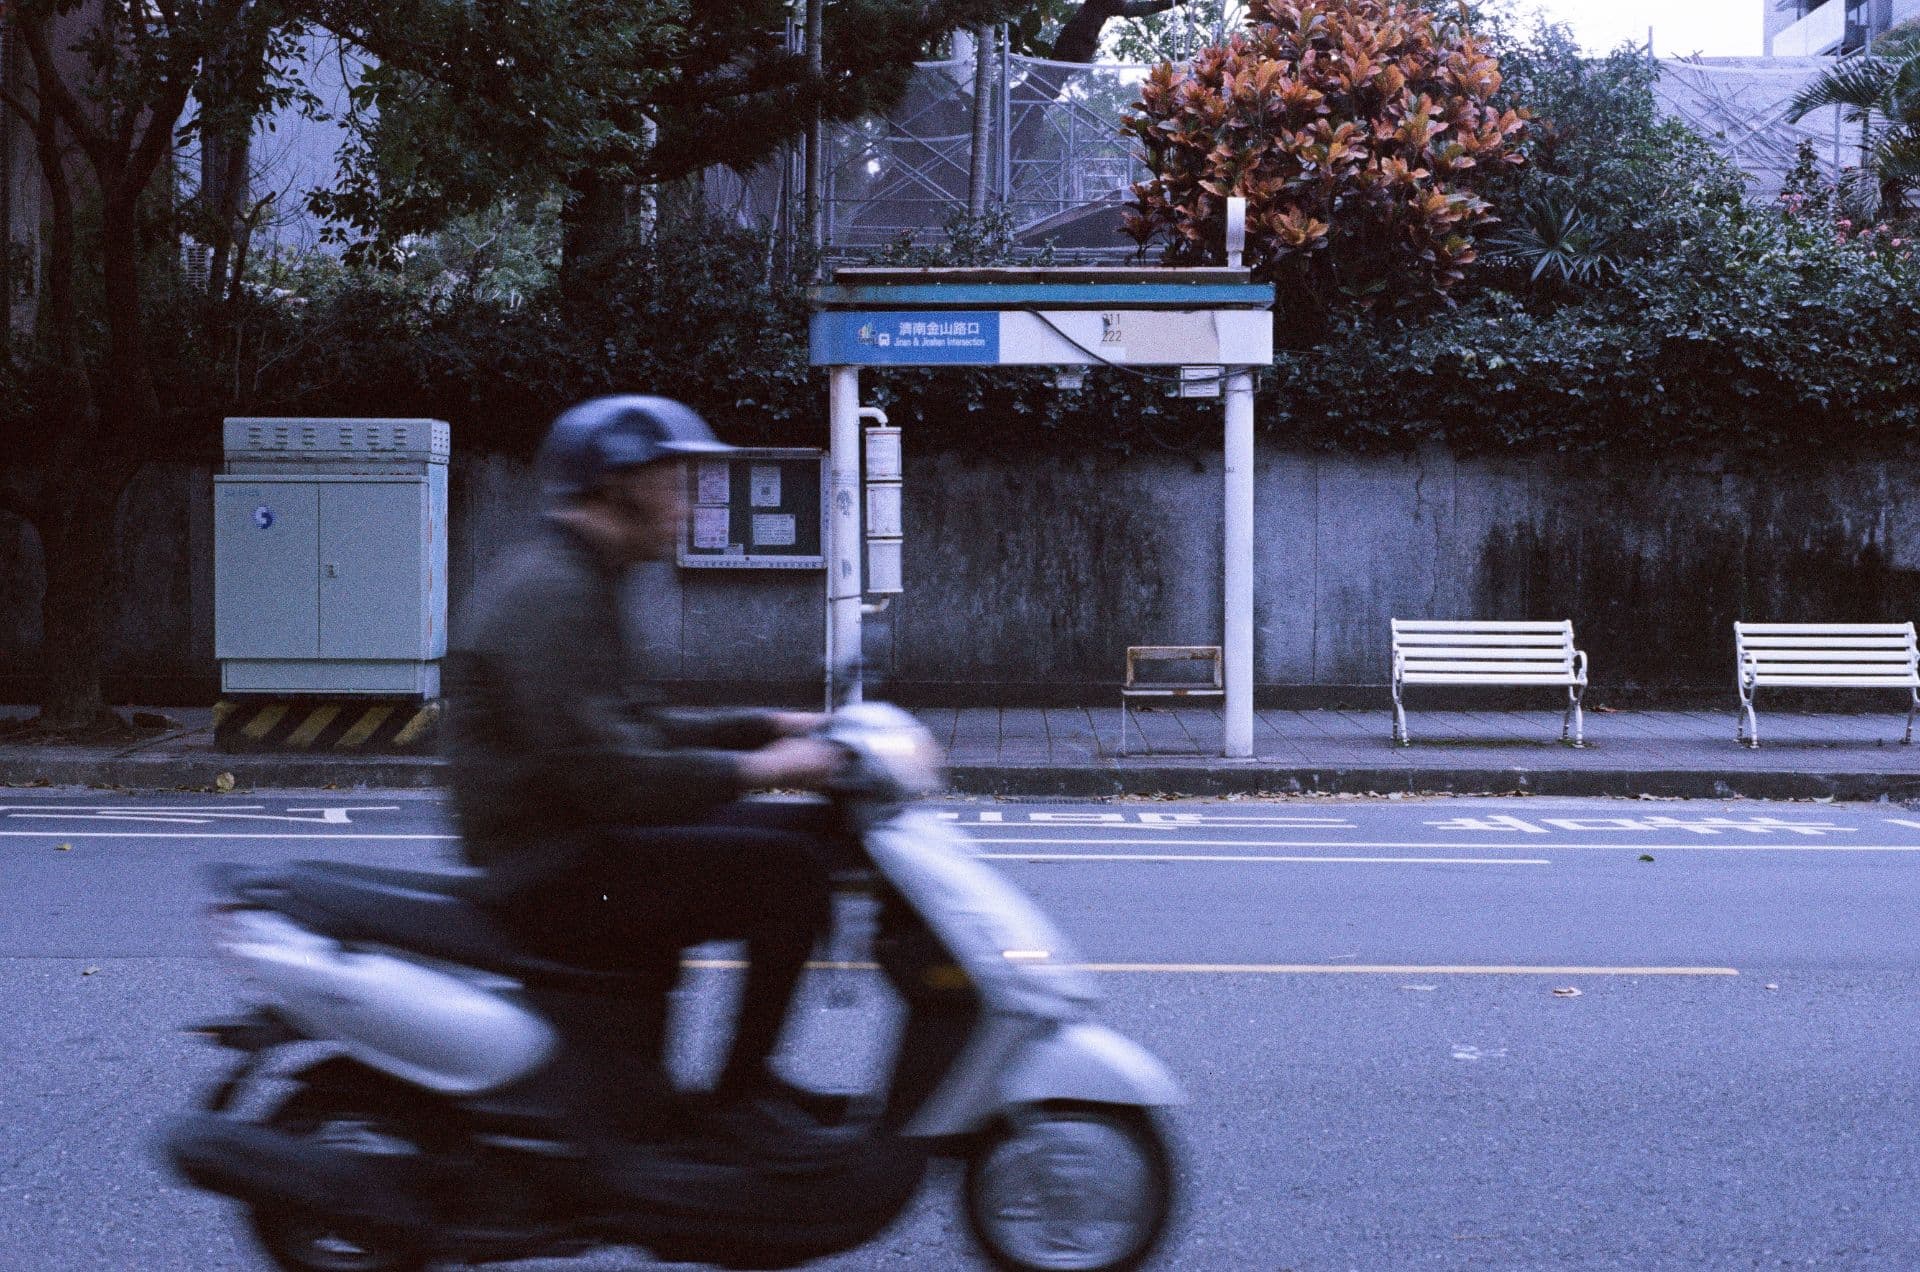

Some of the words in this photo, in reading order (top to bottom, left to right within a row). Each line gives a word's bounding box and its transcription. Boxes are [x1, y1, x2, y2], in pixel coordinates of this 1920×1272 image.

[899, 321, 979, 336] 濟南金山路口
[913, 337, 920, 347] &
[946, 337, 986, 347] Intersection
[1102, 330, 1122, 342] 222
